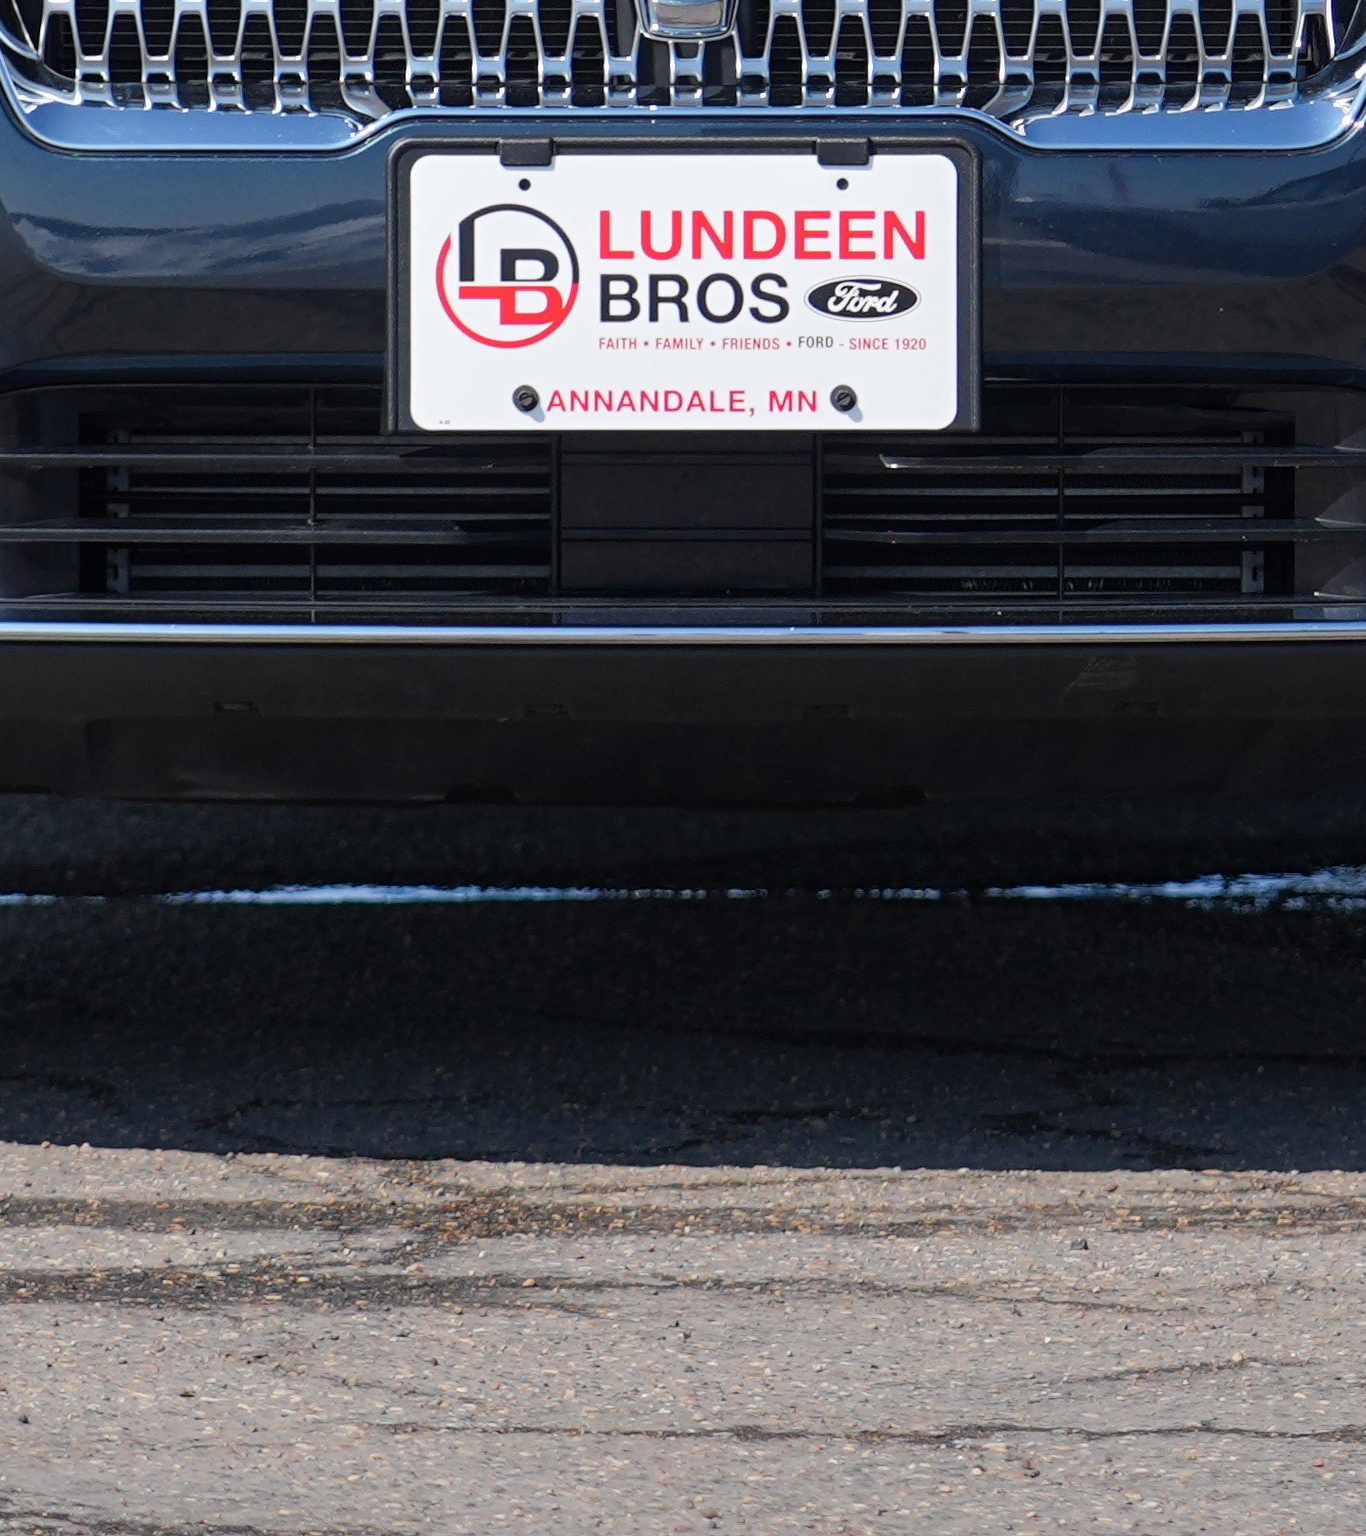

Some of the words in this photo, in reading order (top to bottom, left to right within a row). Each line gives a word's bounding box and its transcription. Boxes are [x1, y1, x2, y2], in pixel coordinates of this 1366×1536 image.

[599, 209, 926, 261] LUNDEEN
[599, 272, 790, 325] BROS
[827, 281, 900, 313] Ford
[598, 337, 637, 350] FAITH
[655, 337, 704, 350] FAMILY
[722, 337, 780, 350] FRIENDS
[798, 335, 834, 349] FORD
[849, 337, 889, 351] SINCE
[894, 337, 927, 351] 1920
[546, 389, 755, 417] ANNANDALE,
[768, 389, 818, 413] MN
